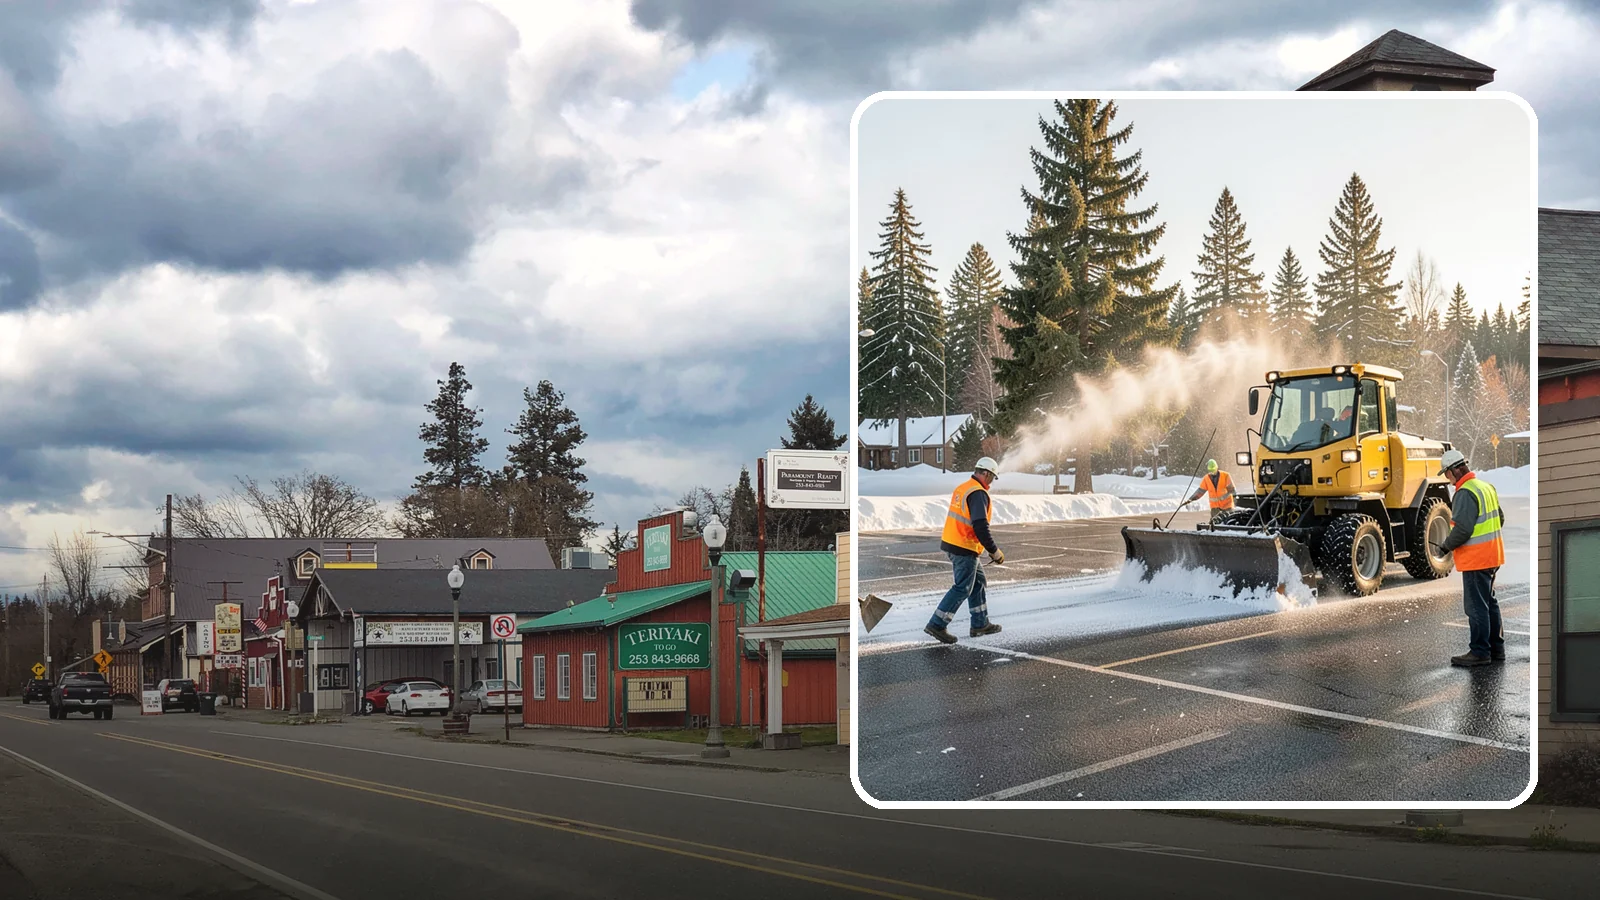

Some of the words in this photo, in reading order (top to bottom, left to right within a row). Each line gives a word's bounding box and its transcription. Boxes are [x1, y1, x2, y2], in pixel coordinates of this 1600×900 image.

[625, 627, 702, 646] TERIYAKI
[654, 643, 664, 651] TO
[665, 643, 676, 651] GO
[629, 654, 648, 665] 253
[651, 653, 700, 664] 843-9668
